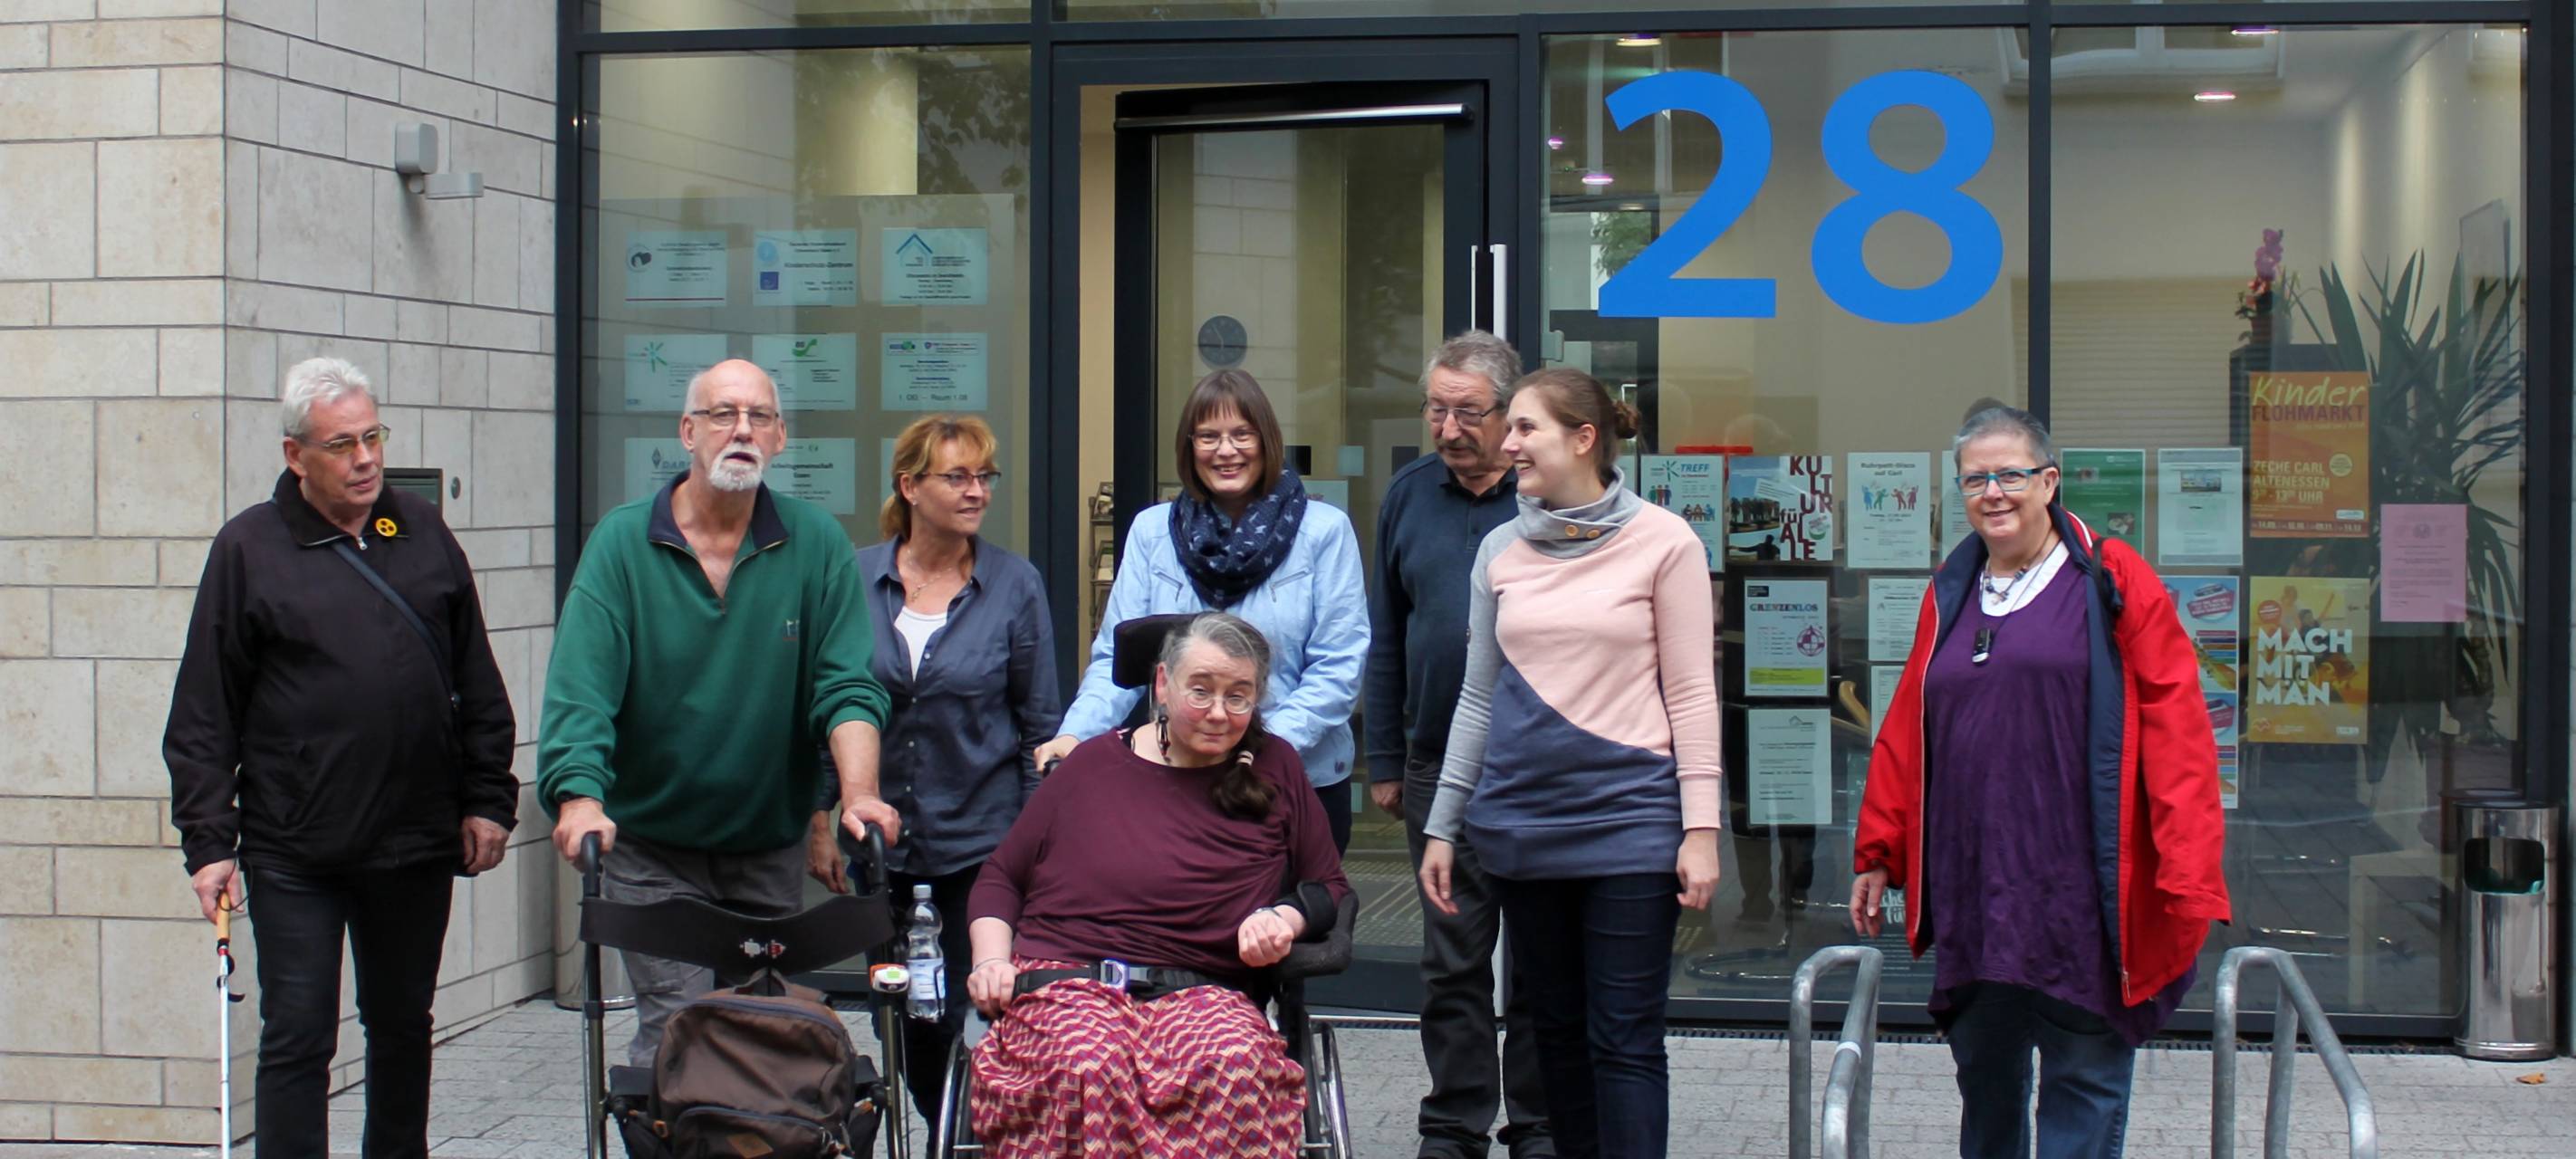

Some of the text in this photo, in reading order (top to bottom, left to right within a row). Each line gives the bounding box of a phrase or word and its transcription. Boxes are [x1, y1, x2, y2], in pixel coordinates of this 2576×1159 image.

[1598, 68, 2004, 325] 28
[2253, 376, 2367, 407] Kinder
[2252, 404, 2364, 422] FLOHMARKT
[1680, 463, 1710, 473] TREFF
[2253, 460, 2291, 474] ZECHE
[2294, 461, 2324, 474] CARL
[2253, 475, 2331, 490] ALTENESSEN
[2299, 491, 2323, 504] UHR
[1749, 603, 1819, 612] GRENZENLOS
[2257, 627, 2353, 653] MACH
[2256, 654, 2315, 679] MIT
